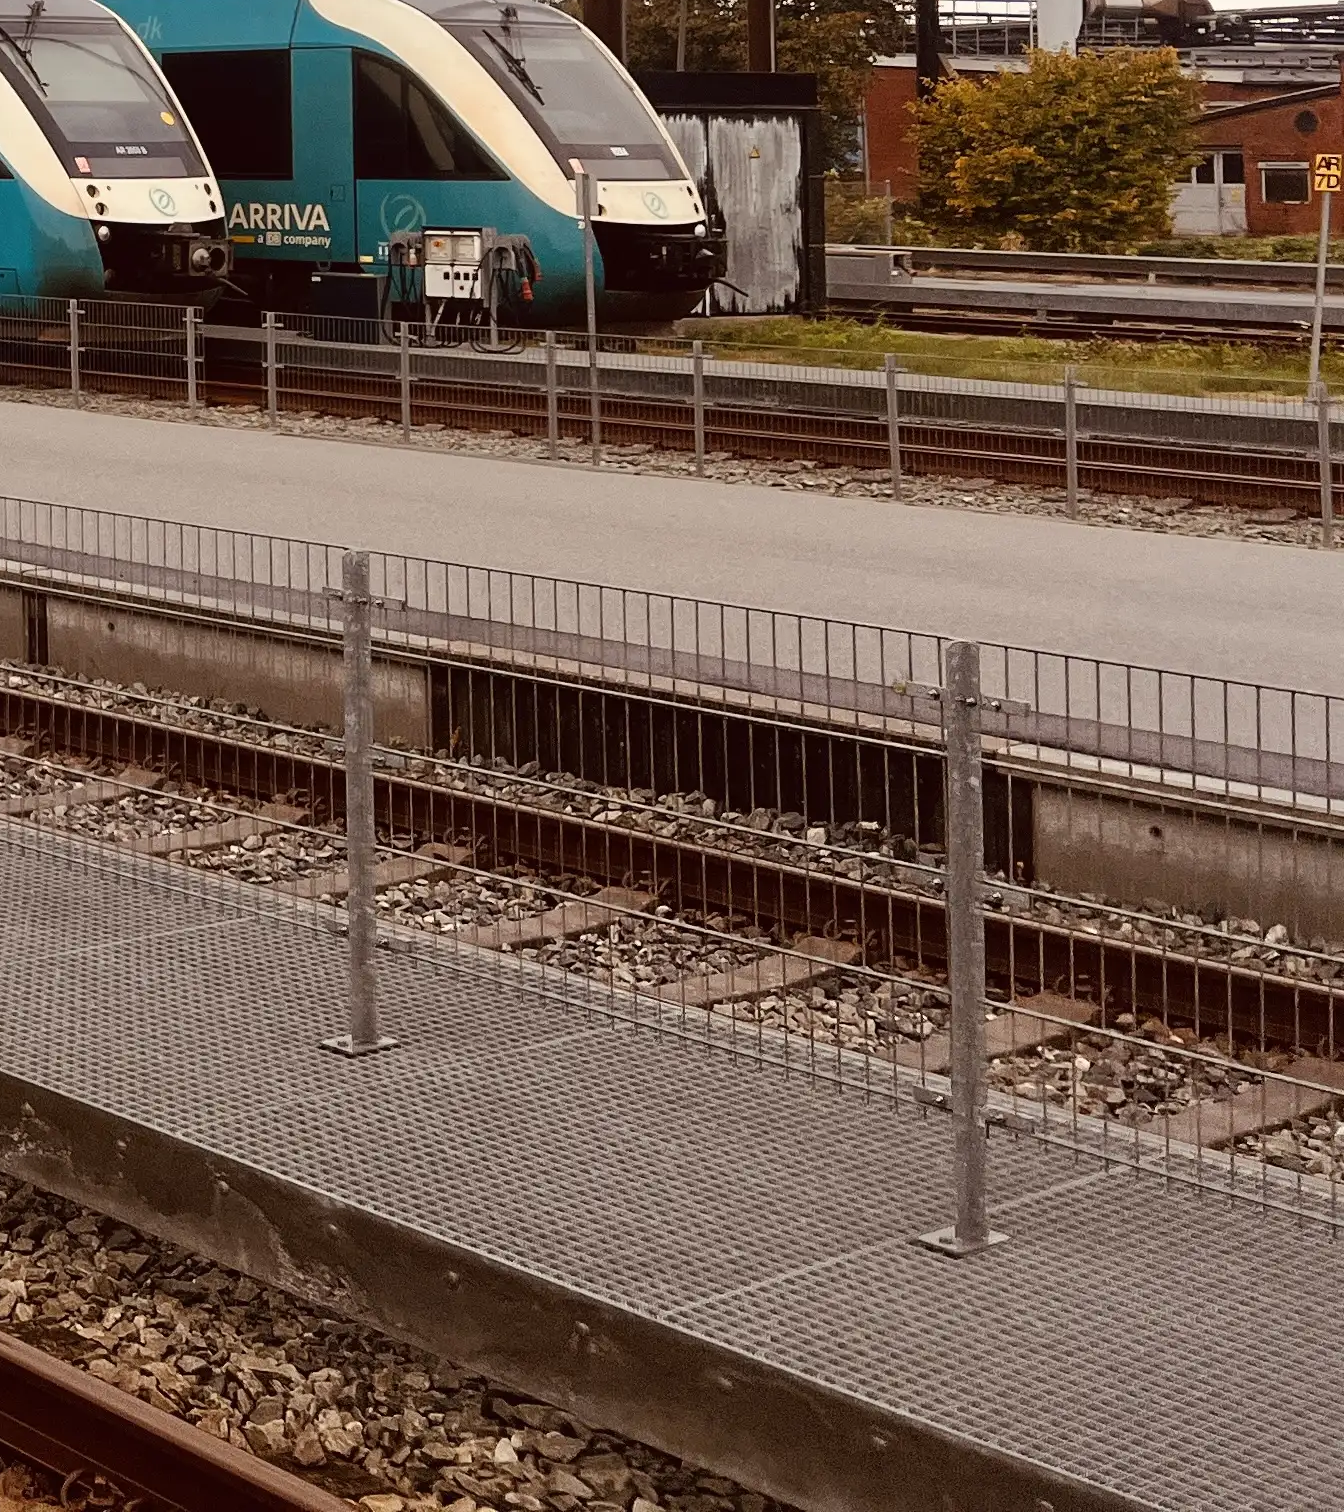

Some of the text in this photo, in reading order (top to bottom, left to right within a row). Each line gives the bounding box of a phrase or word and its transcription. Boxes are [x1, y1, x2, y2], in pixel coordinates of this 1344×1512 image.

[1317, 156, 1340, 171] AR
[1316, 173, 1339, 188] 7D
[228, 203, 330, 231] ARRIVA
[257, 234, 264, 244] a
[283, 235, 331, 249] company
